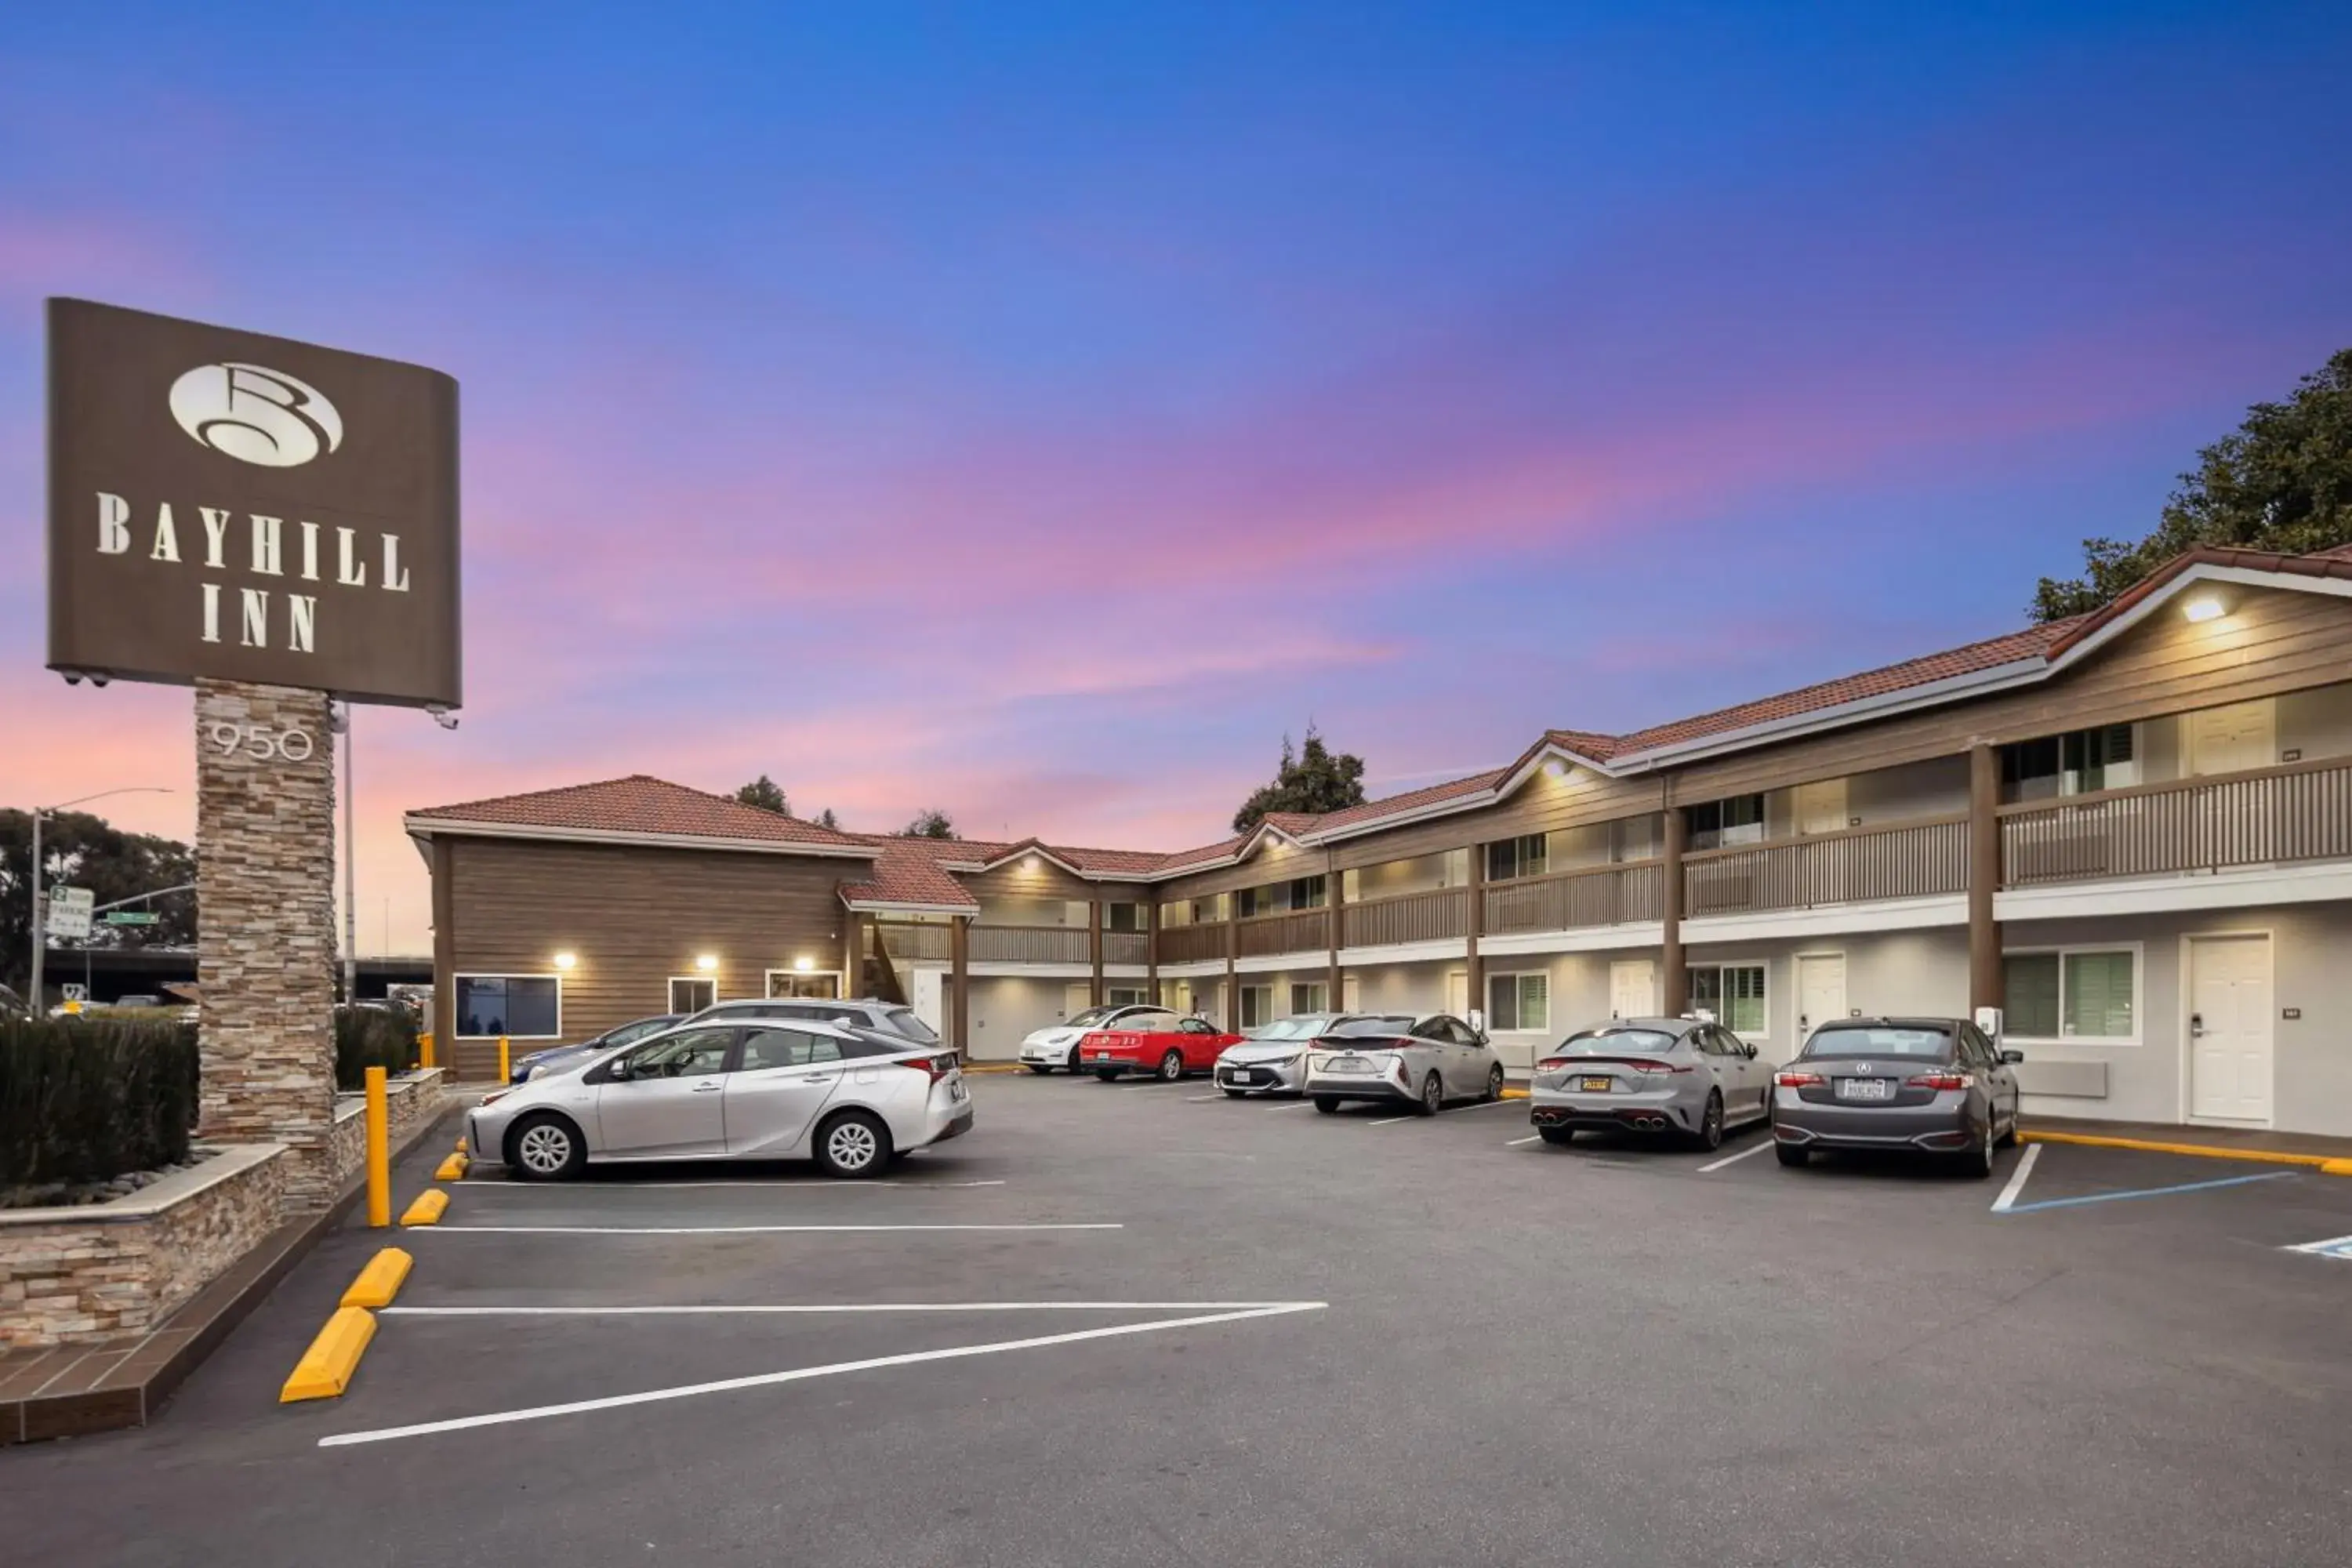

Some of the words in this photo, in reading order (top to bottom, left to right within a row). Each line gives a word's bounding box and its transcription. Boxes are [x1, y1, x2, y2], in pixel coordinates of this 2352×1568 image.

[95, 491, 410, 593] BAYHILL
[201, 583, 318, 654] INN
[211, 724, 314, 762] 950
